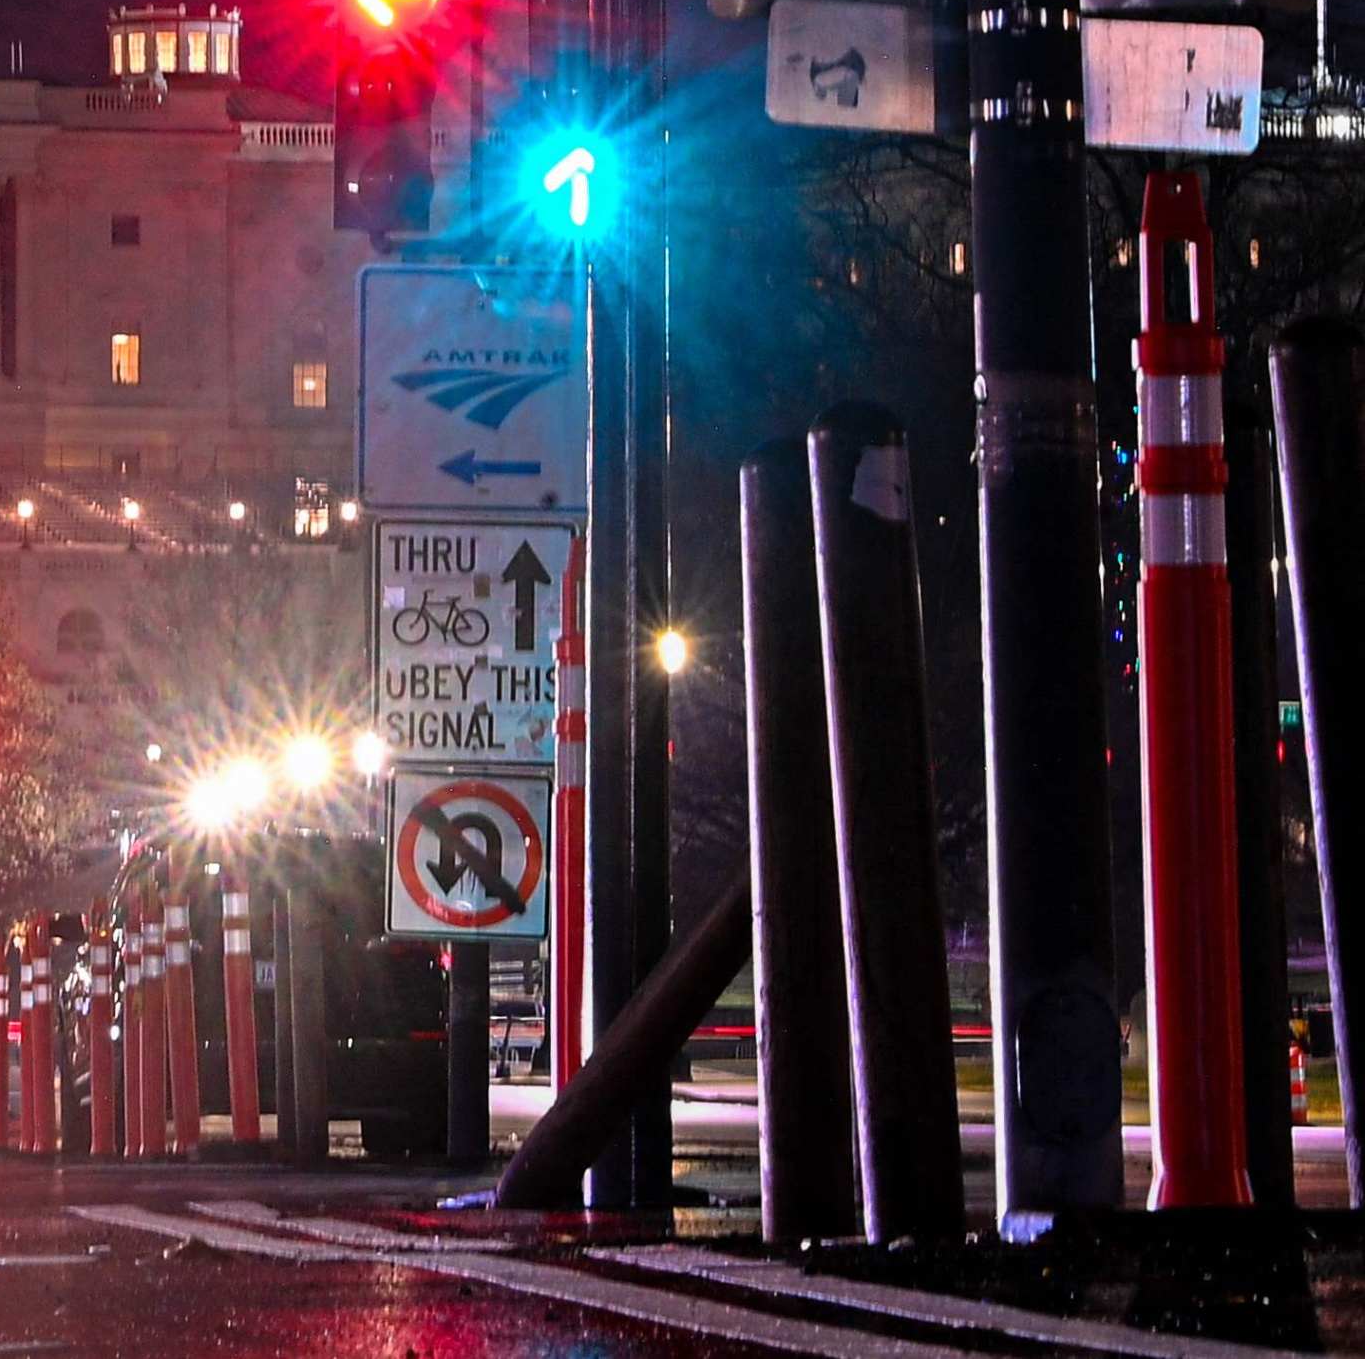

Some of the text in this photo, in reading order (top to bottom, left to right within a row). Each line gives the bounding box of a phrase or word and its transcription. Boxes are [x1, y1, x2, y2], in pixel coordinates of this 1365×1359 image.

[422, 348, 571, 366] AMTRAK
[388, 535, 477, 573] THRU
[386, 710, 506, 749] SIGNAL
